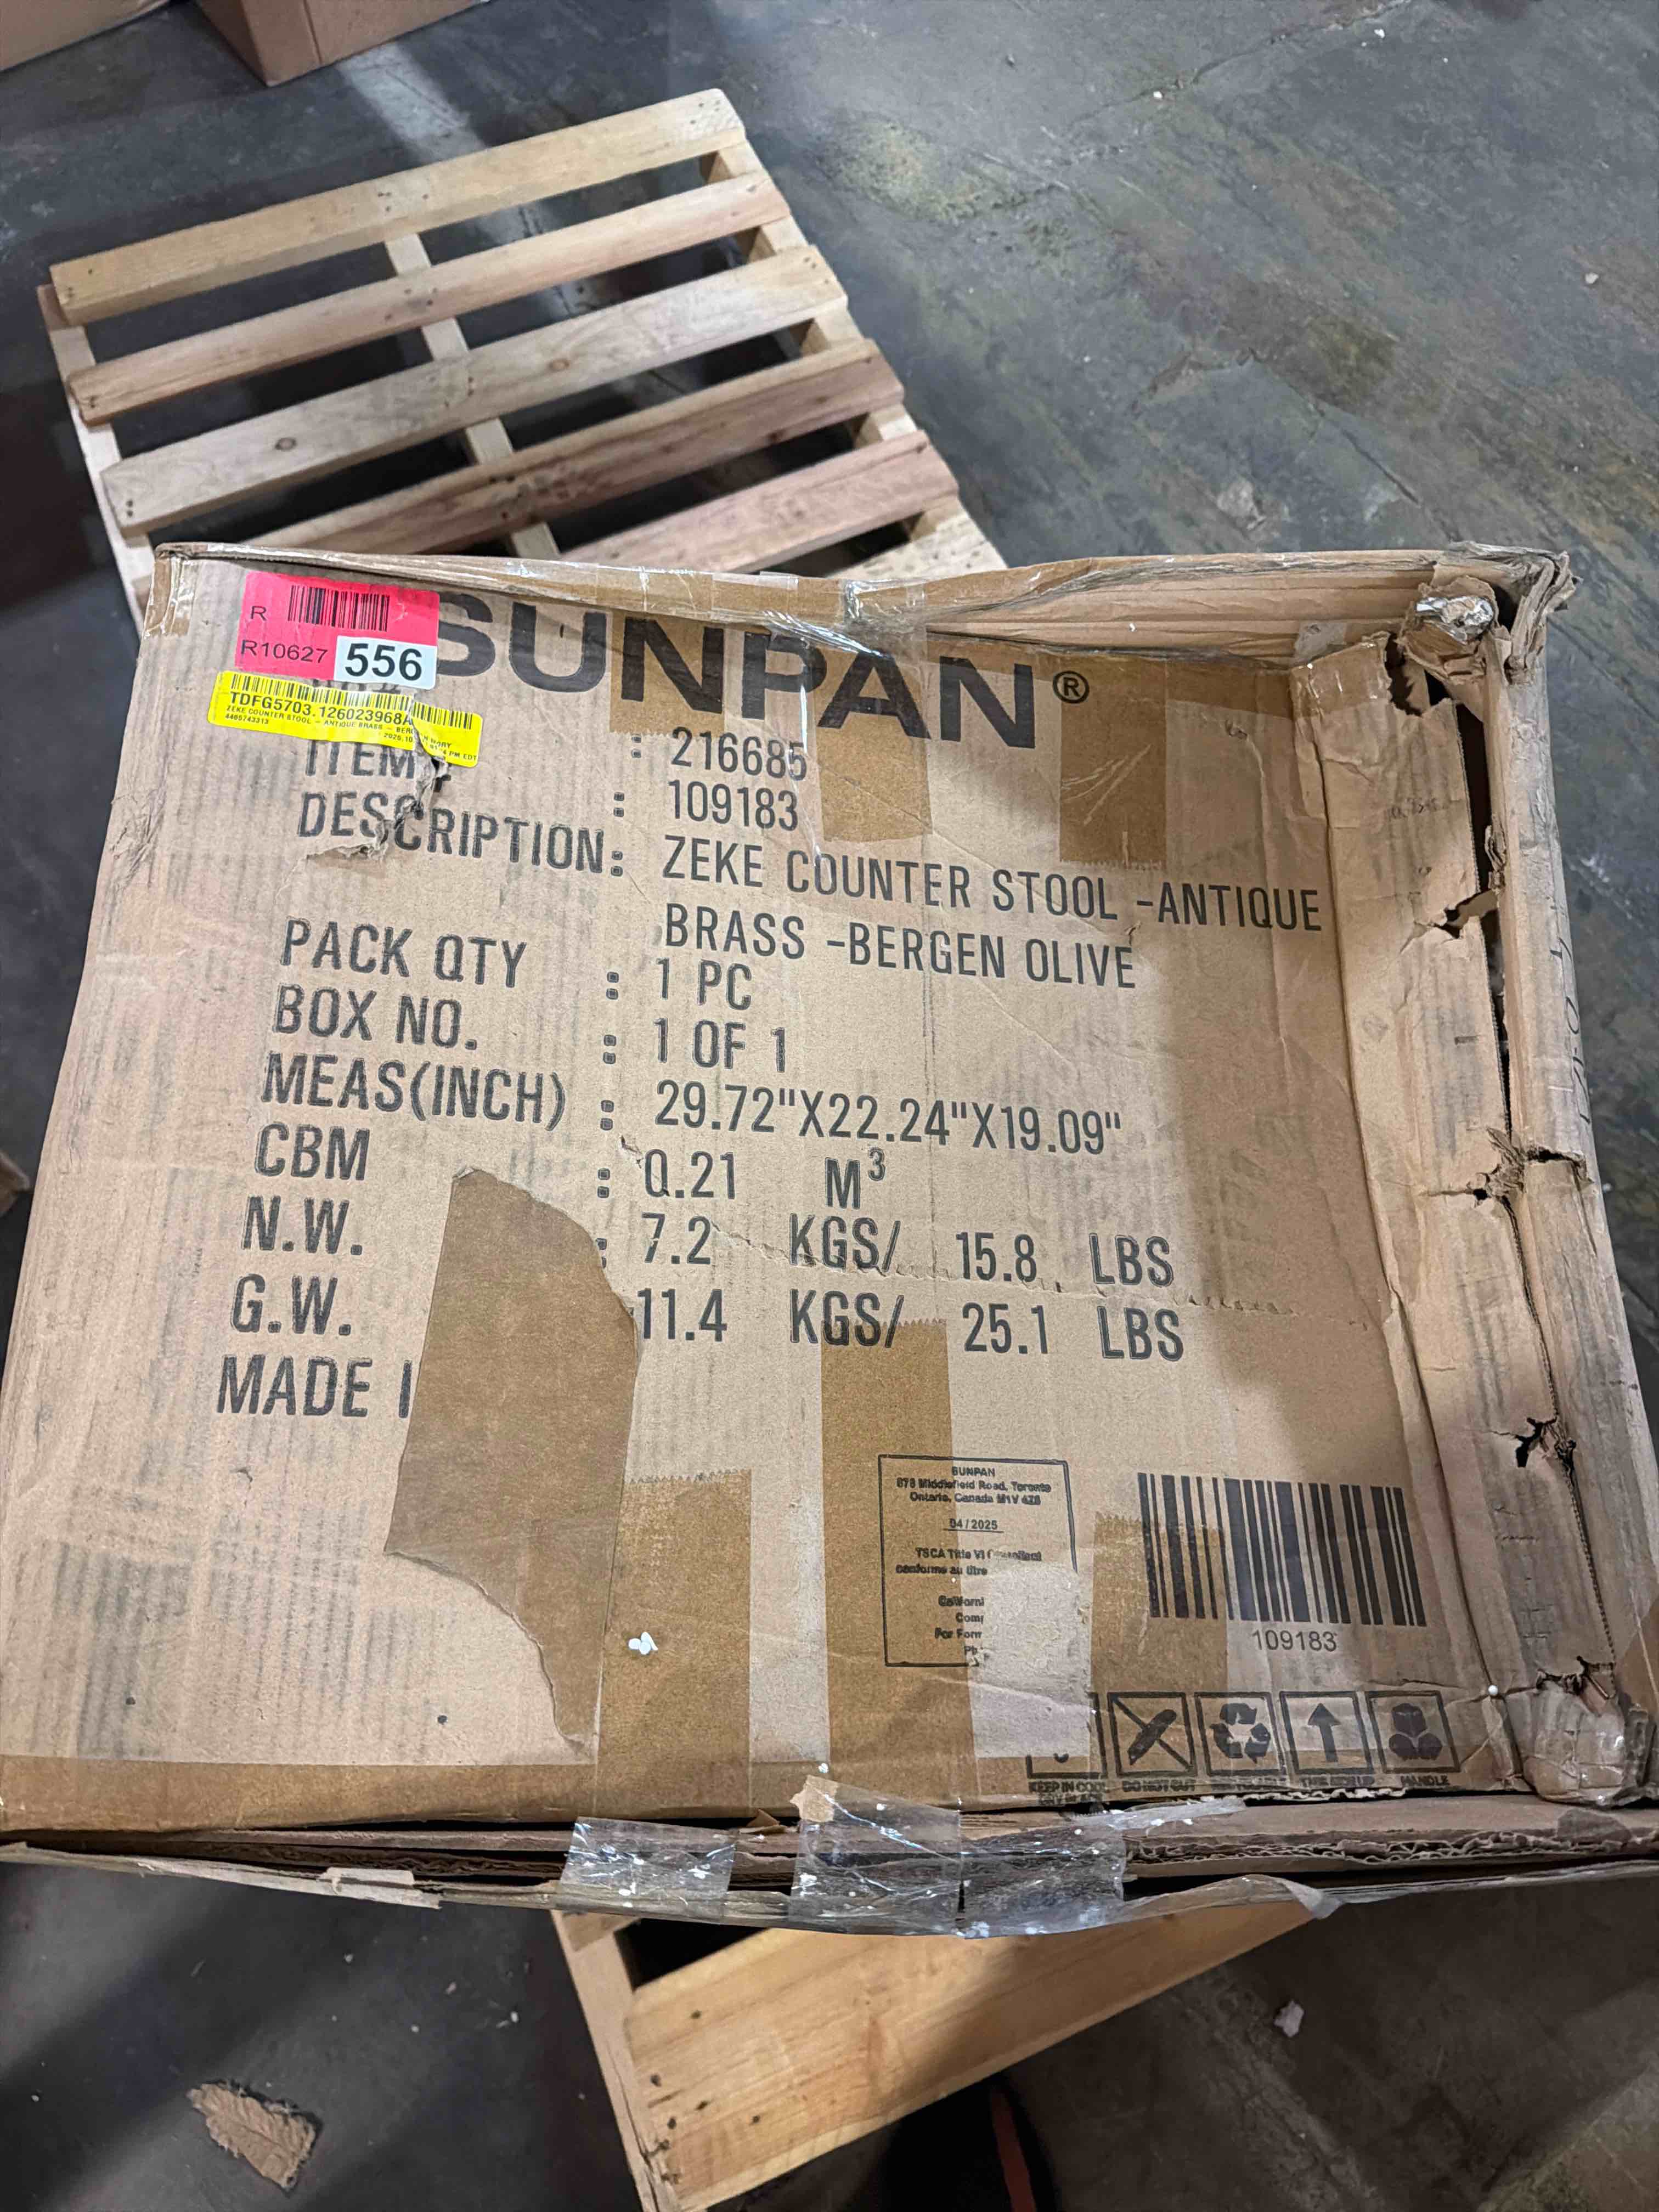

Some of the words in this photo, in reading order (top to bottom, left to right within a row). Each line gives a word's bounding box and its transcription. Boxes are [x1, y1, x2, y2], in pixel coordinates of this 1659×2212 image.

[250, 605, 267, 621] R
[240, 639, 328, 664] R10627
[344, 642, 423, 682] 556
[226, 705, 246, 714] ZEKE
[248, 708, 285, 720] COUNTER
[286, 714, 312, 724] STOOL
[324, 720, 356, 728] ANTIQUE
[670, 726, 808, 781] 216685
[668, 779, 799, 831] 109183
[662, 834, 763, 888] ZEKE
[786, 849, 970, 909] COUNTER
[992, 868, 1118, 921] STOOL
[280, 915, 413, 977] PACK
[433, 933, 527, 988] QTY
[656, 957, 670, 1000] 1
[696, 958, 752, 1011] PC
[665, 902, 805, 960] BRASS
[1025, 938, 1136, 988] OLIVE
[272, 984, 377, 1041] BOX
[396, 994, 478, 1051] NO.
[653, 1018, 668, 1063] 1
[692, 1019, 746, 1069] OF
[771, 1027, 786, 1073] 1
[261, 1050, 566, 1131] MEAS(INCH)
[254, 1121, 370, 1181] CBM
[644, 1149, 736, 1200] 0.21
[241, 1195, 363, 1256] N.W.
[641, 1211, 712, 1265] 7.2
[789, 1212, 901, 1272] KGS/
[956, 1232, 1038, 1283] 15.8
[1088, 1232, 1175, 1287] LBS
[230, 1273, 352, 1336] G.W.
[636, 1287, 727, 1342] 11.4
[789, 1288, 904, 1348] KGS/
[962, 1301, 1049, 1355] 25.1
[1096, 1305, 1184, 1362] LBS
[217, 1353, 373, 1418] MADE
[951, 1465, 996, 1477] SUNPAN
[916, 1547, 945, 1559] TSCA
[1251, 1629, 1339, 1652] 109183
[1061, 1780, 1075, 1792] IN
